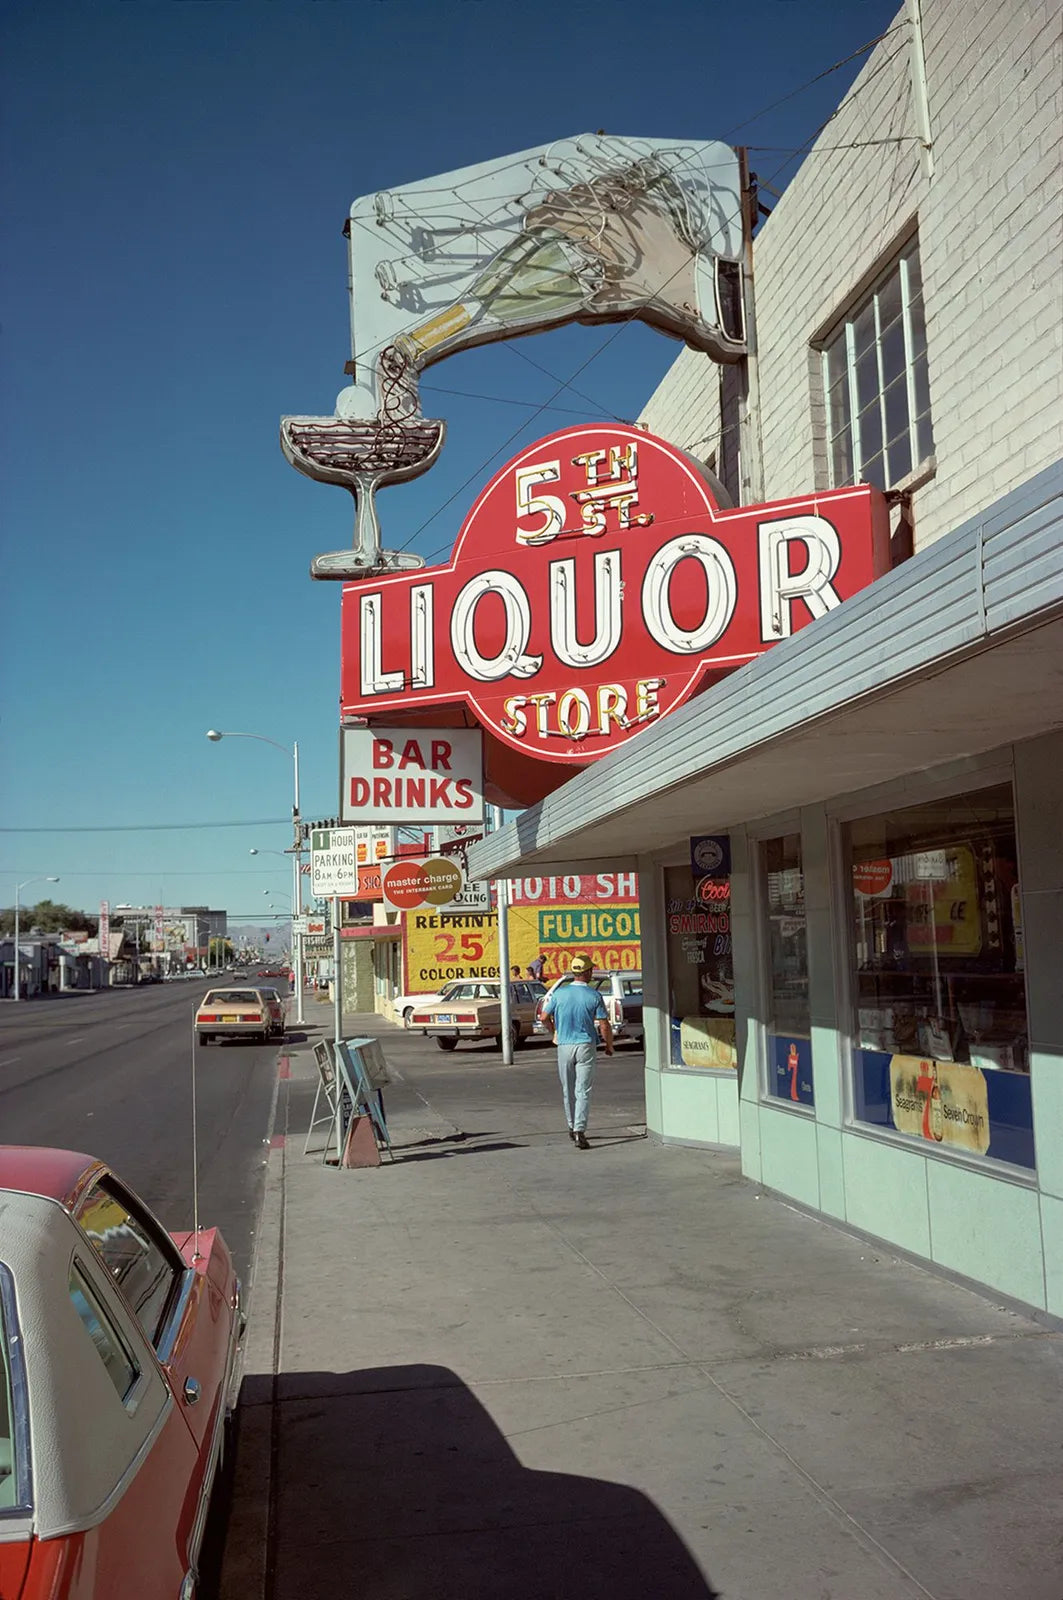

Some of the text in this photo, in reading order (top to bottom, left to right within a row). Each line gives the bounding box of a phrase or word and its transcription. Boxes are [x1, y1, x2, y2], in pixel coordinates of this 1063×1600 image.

[581, 492, 653, 537] ST.
[360, 515, 842, 696] LIQUOR
[502, 678, 661, 739] STORE
[372, 739, 452, 770] BAR
[350, 777, 474, 809] DRINKS
[319, 833, 325, 848] 1
[331, 835, 353, 847] HOUR
[314, 853, 353, 867] PARKING
[387, 872, 459, 888] master charge
[406, 885, 437, 894] INTERBANK
[438, 883, 454, 891] CARD
[596, 872, 635, 897] SH
[670, 913, 729, 934] SMIRNO
[543, 948, 641, 975] KOACO
[420, 968, 465, 980] COLOR
[943, 1105, 984, 1128] Seven Crown
